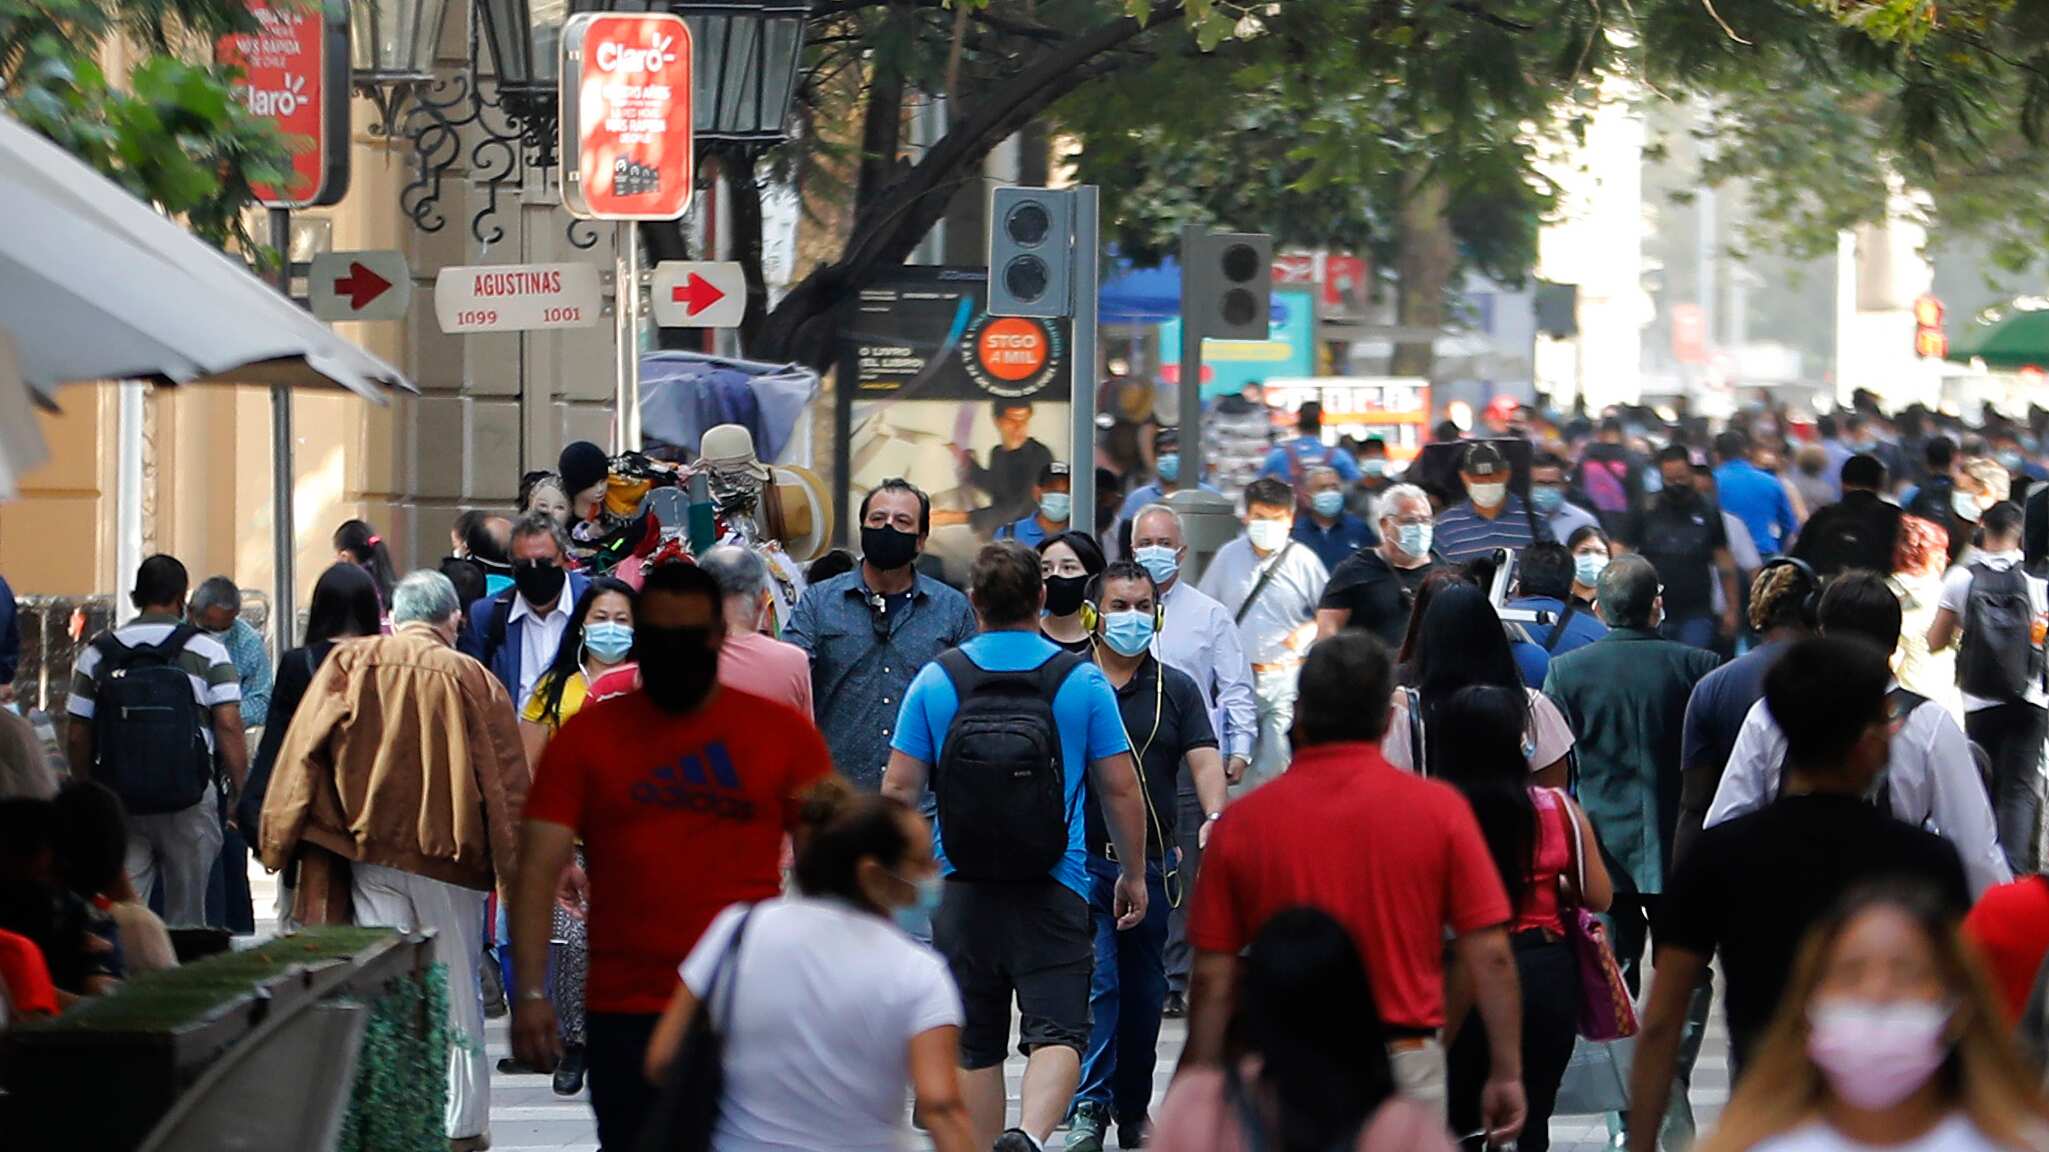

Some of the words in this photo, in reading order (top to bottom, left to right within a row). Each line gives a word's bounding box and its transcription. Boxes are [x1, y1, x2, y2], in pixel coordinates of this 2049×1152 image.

[596, 38, 664, 73] Claro
[474, 271, 561, 297] AGUSTINAS
[457, 310, 497, 325] 1099
[543, 306, 580, 322] 1001
[987, 334, 1037, 349] STGO
[1004, 351, 1038, 364] MIL
